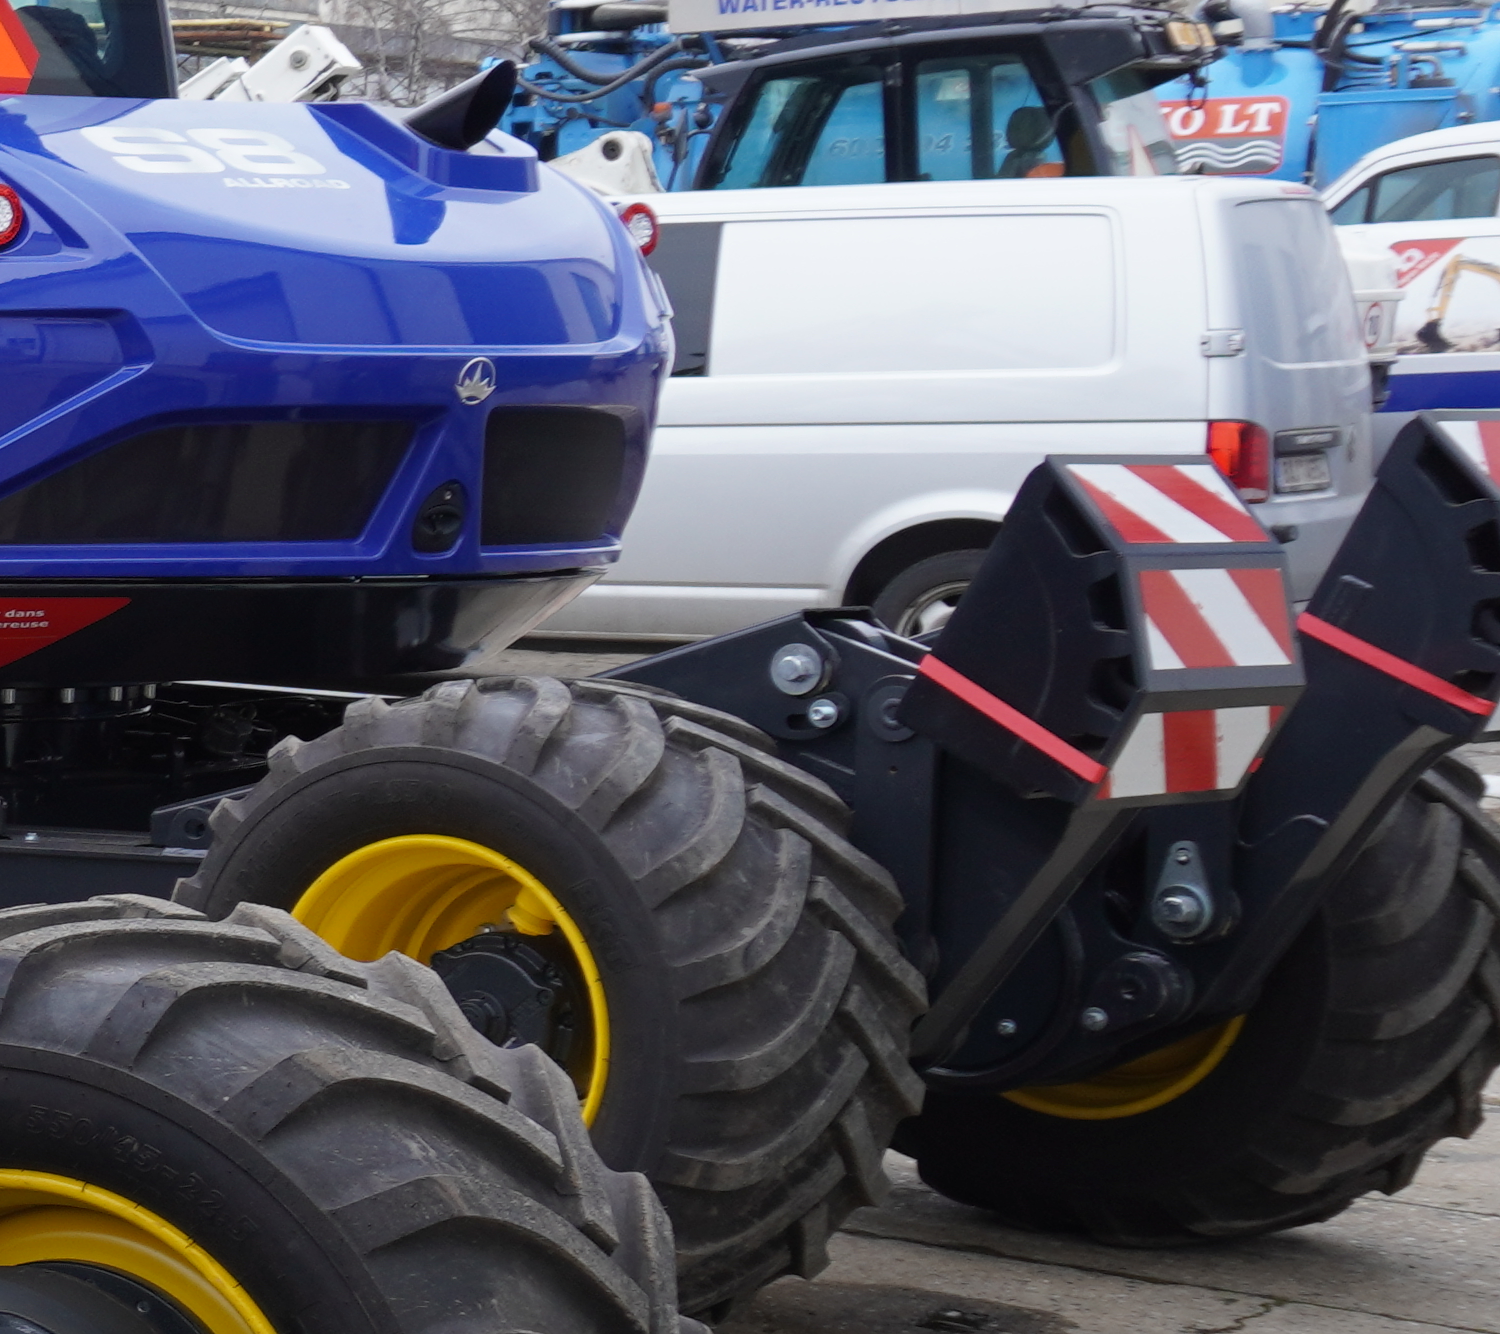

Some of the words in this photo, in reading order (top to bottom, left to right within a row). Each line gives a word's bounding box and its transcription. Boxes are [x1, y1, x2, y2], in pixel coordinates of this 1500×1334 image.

[82, 126, 327, 175] S8
[223, 176, 350, 190] ALLROAD
[4, 608, 45, 619] dans
